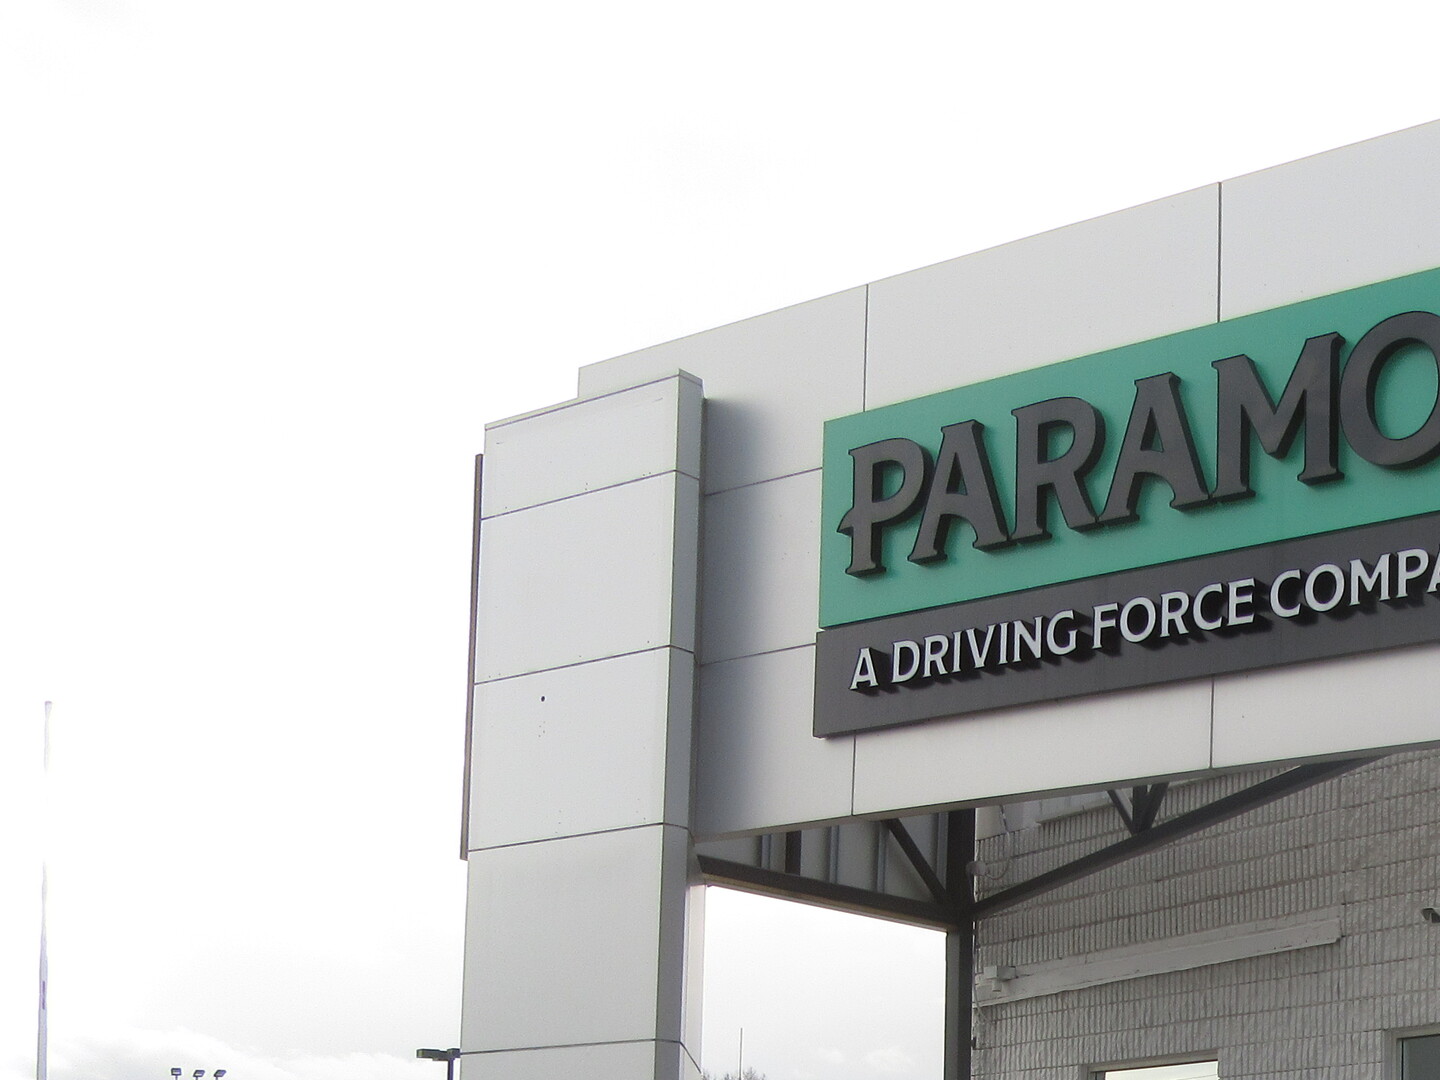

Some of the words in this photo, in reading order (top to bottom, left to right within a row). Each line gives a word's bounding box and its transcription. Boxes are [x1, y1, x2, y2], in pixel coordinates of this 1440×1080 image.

[849, 647, 879, 690] A
[891, 609, 1079, 684] DRIVING
[1092, 577, 1257, 649] FORCE
